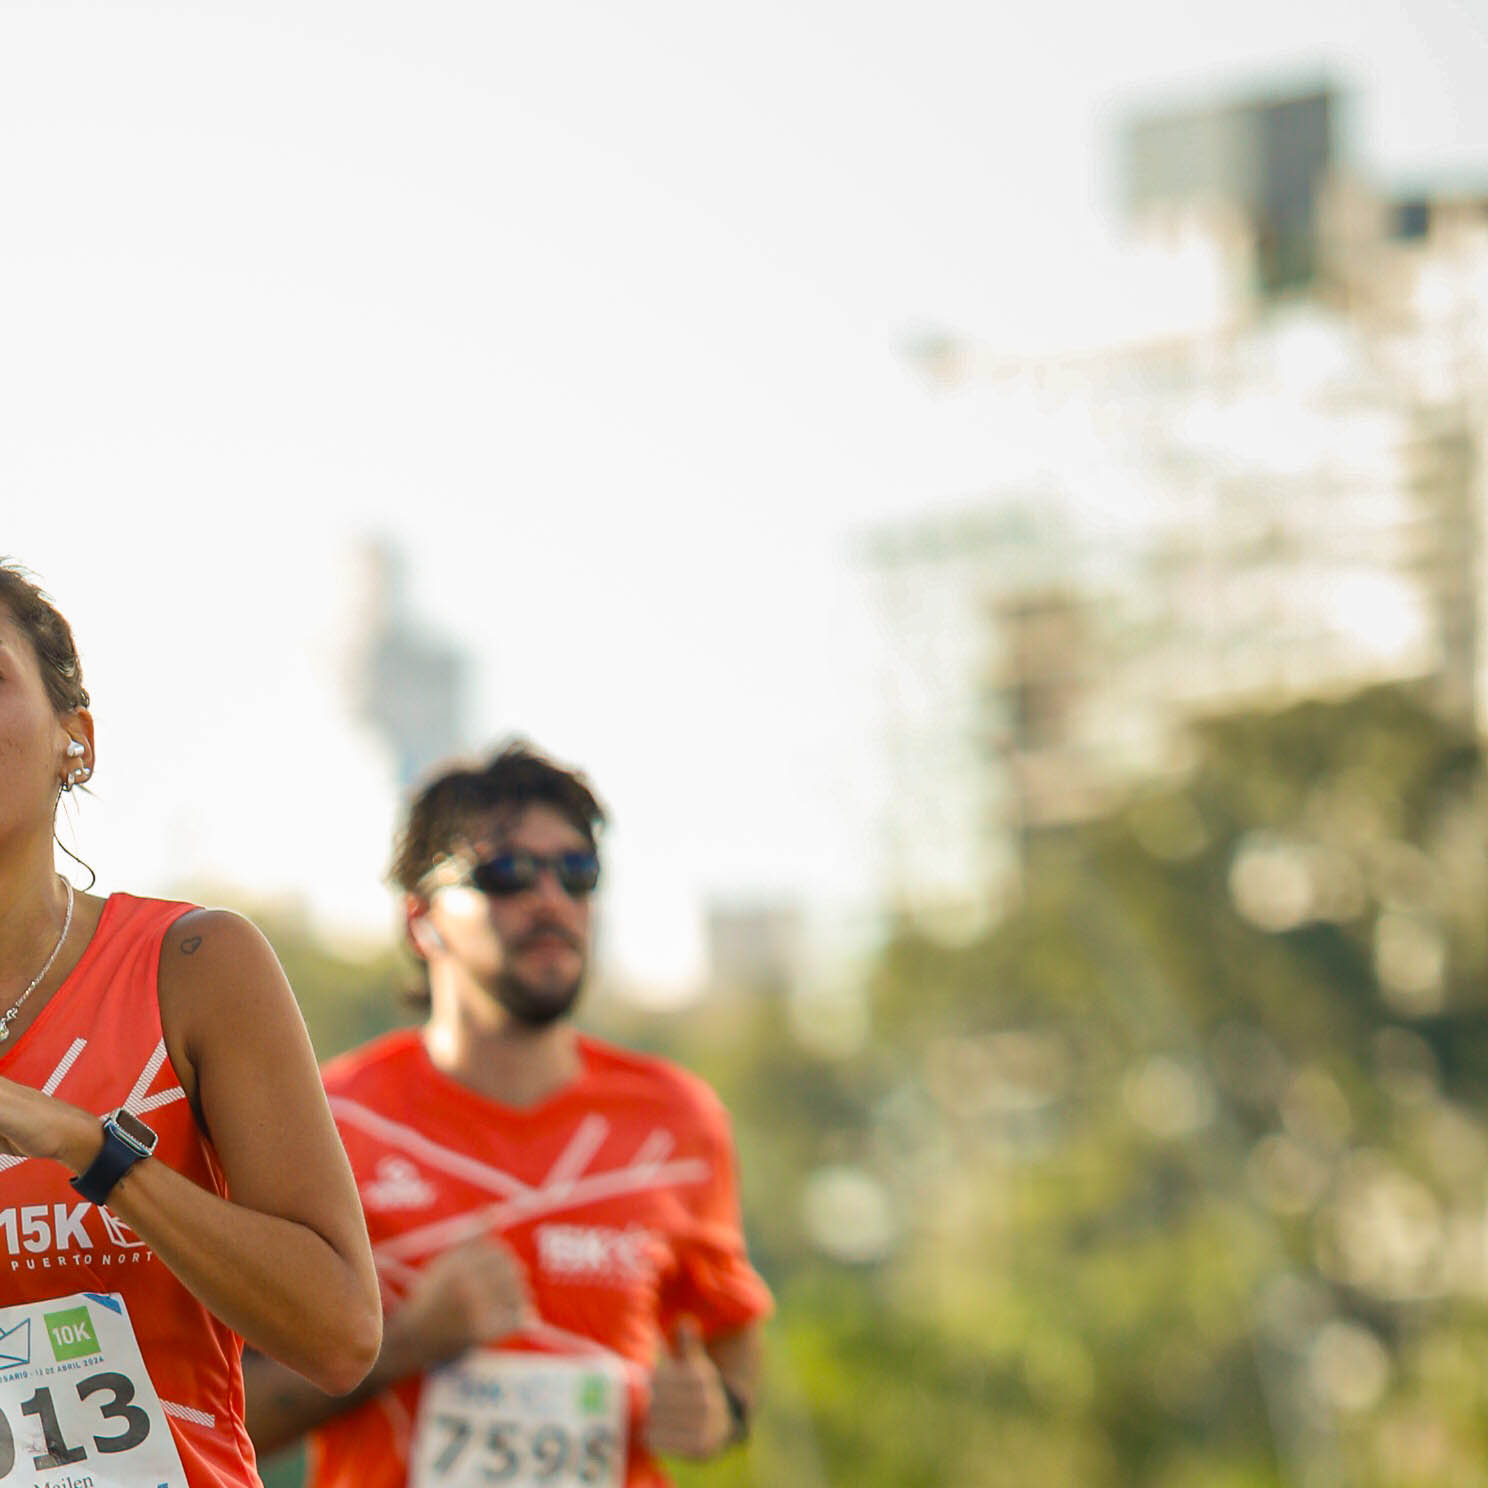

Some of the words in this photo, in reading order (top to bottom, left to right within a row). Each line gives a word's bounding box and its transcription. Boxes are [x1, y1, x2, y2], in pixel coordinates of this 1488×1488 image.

[10, 1254, 92, 1272] PUERTO
[102, 1251, 153, 1265] NORT
[52, 1319, 92, 1347] 10K
[57, 1362, 81, 1373] ABRIL
